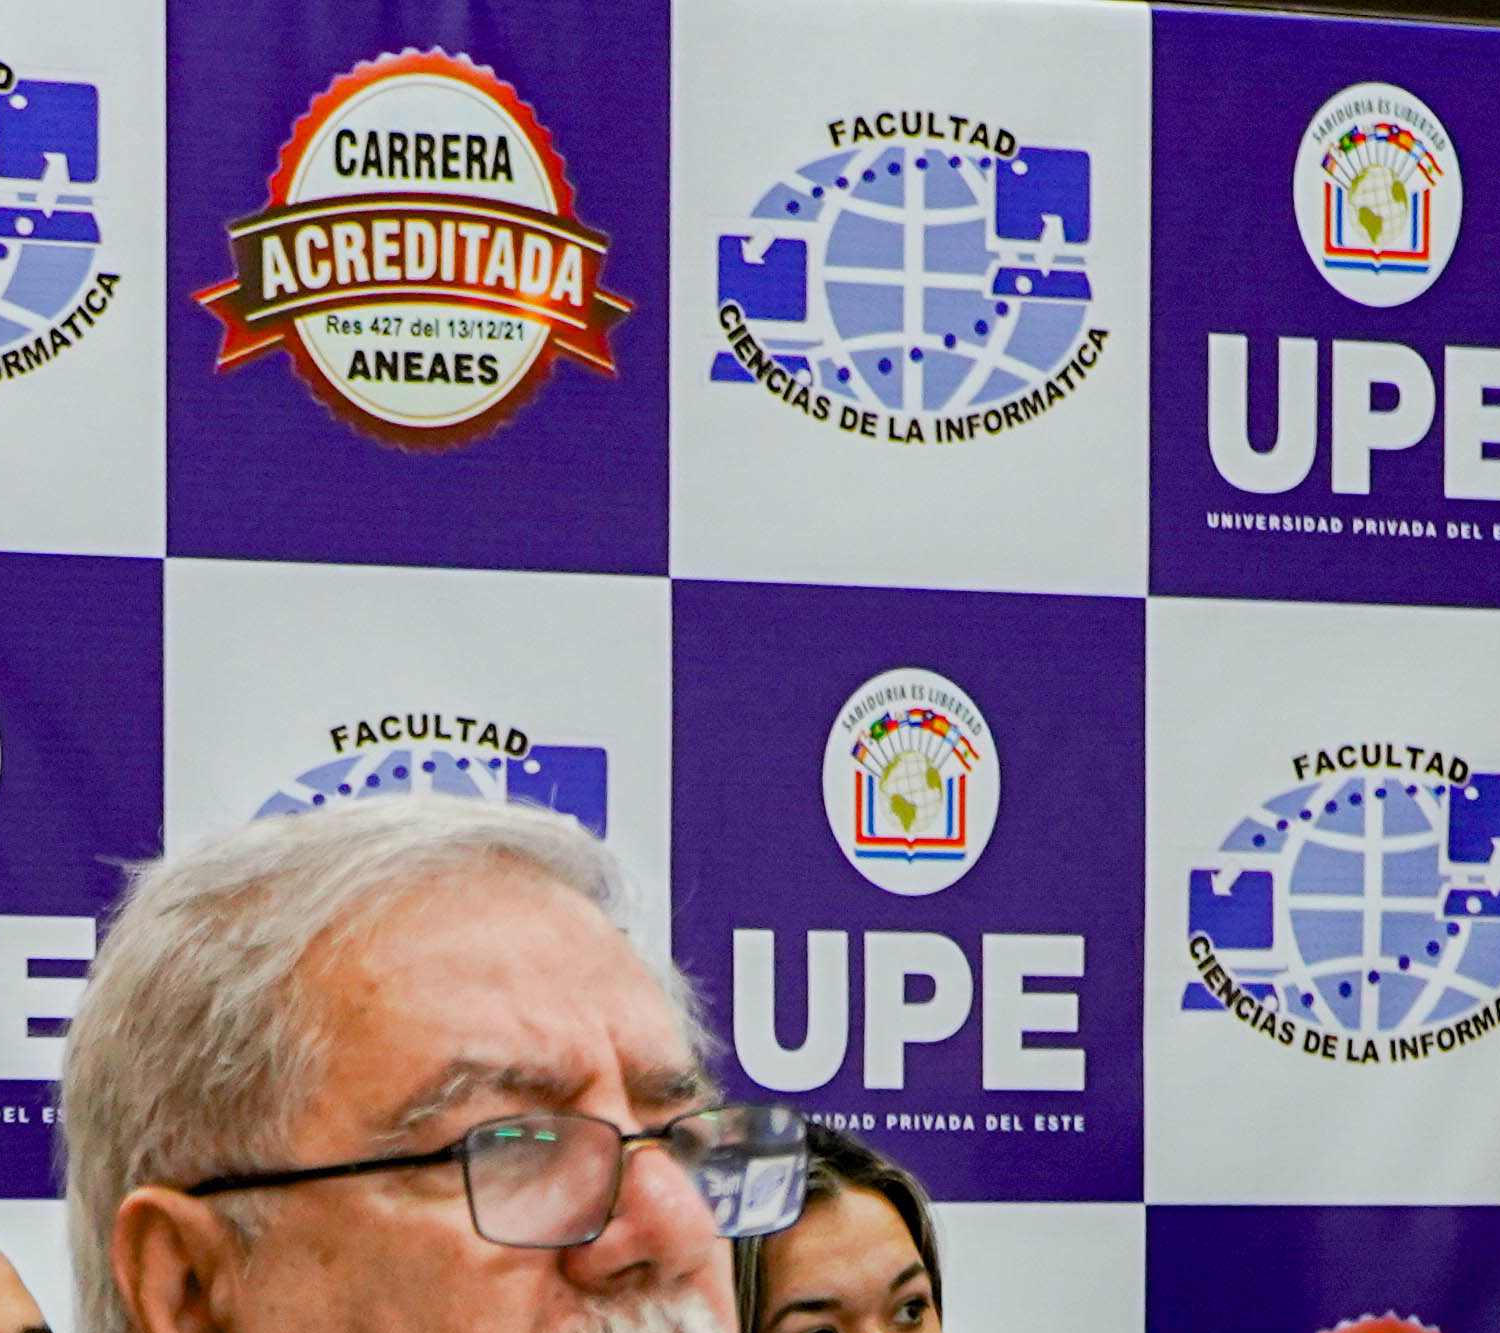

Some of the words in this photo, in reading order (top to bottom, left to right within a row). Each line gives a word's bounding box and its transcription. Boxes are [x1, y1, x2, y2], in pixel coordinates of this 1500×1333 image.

[334, 128, 514, 183] CARRERA
[828, 111, 1017, 159] FACULTAD
[261, 218, 584, 307] ACREDITADA
[326, 315, 363, 336] Res
[370, 316, 403, 337] 427
[410, 316, 440, 338] del
[446, 319, 525, 341] 13/12/21
[347, 349, 499, 386] ANEAES
[719, 303, 832, 422] CIENCIAS
[839, 406, 878, 439] DE
[888, 418, 925, 444] LA
[936, 325, 1110, 444] INFORMATICA
[1207, 511, 1343, 534] UNIVERSIDAD
[1352, 517, 1437, 539] PRIVADA
[1447, 522, 1483, 541] DEL
[330, 713, 528, 757] FACULTAD
[1292, 743, 1470, 785] FACULTAD
[732, 928, 1085, 1092] UPE
[1188, 935, 1295, 1046] CIENCIAS
[1303, 1030, 1337, 1060] DE
[1347, 1038, 1380, 1064] LA
[886, 1114, 974, 1132] PRIVADA
[985, 1114, 1023, 1132] DEL
[1035, 1115, 1086, 1133] ESTE
